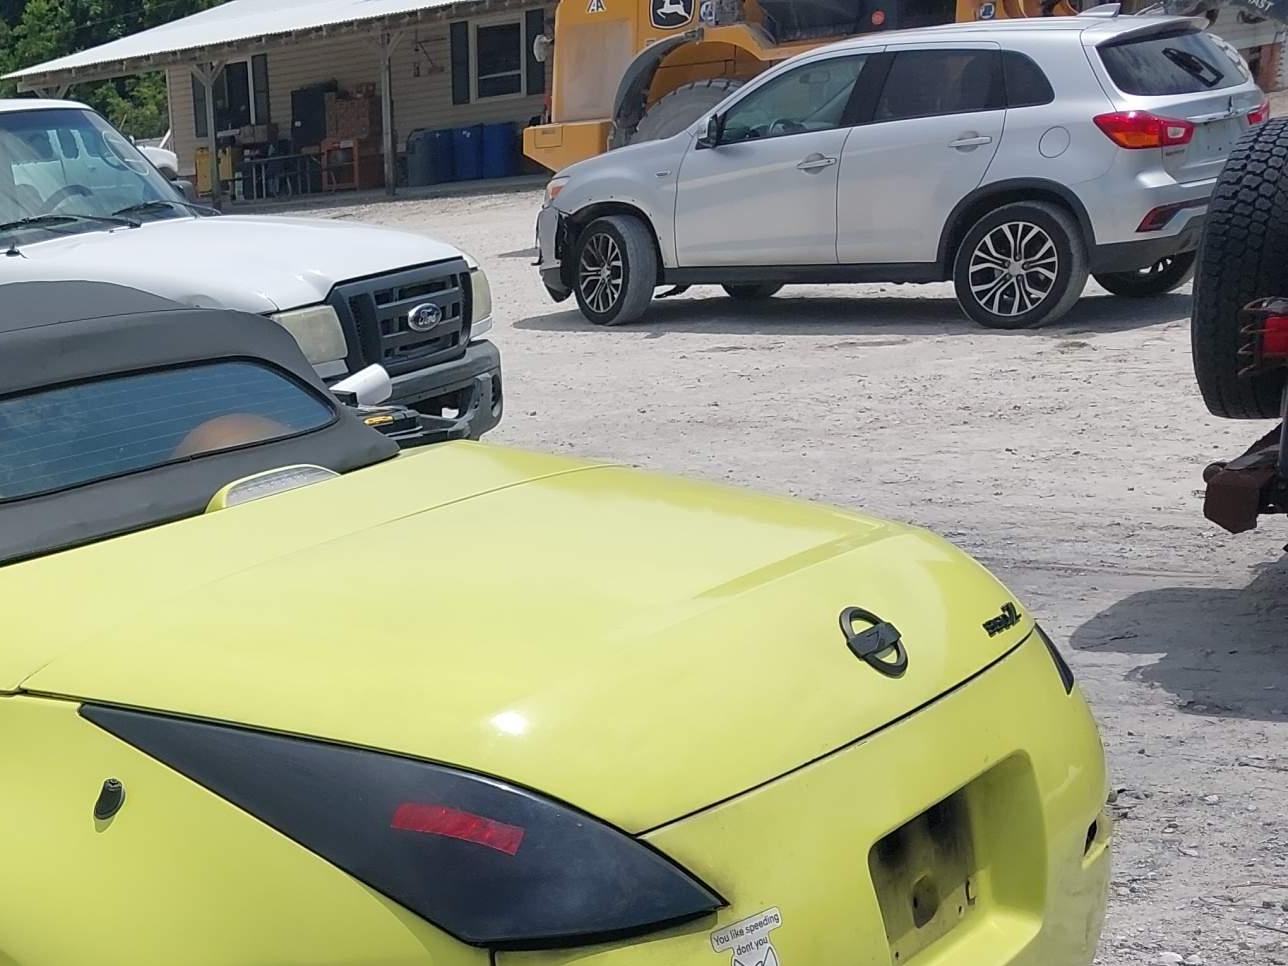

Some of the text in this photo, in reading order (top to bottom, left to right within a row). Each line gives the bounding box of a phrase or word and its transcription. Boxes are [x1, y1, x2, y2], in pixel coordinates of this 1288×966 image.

[714, 914, 779, 946] You like speeding
[737, 937, 768, 956] dont you
